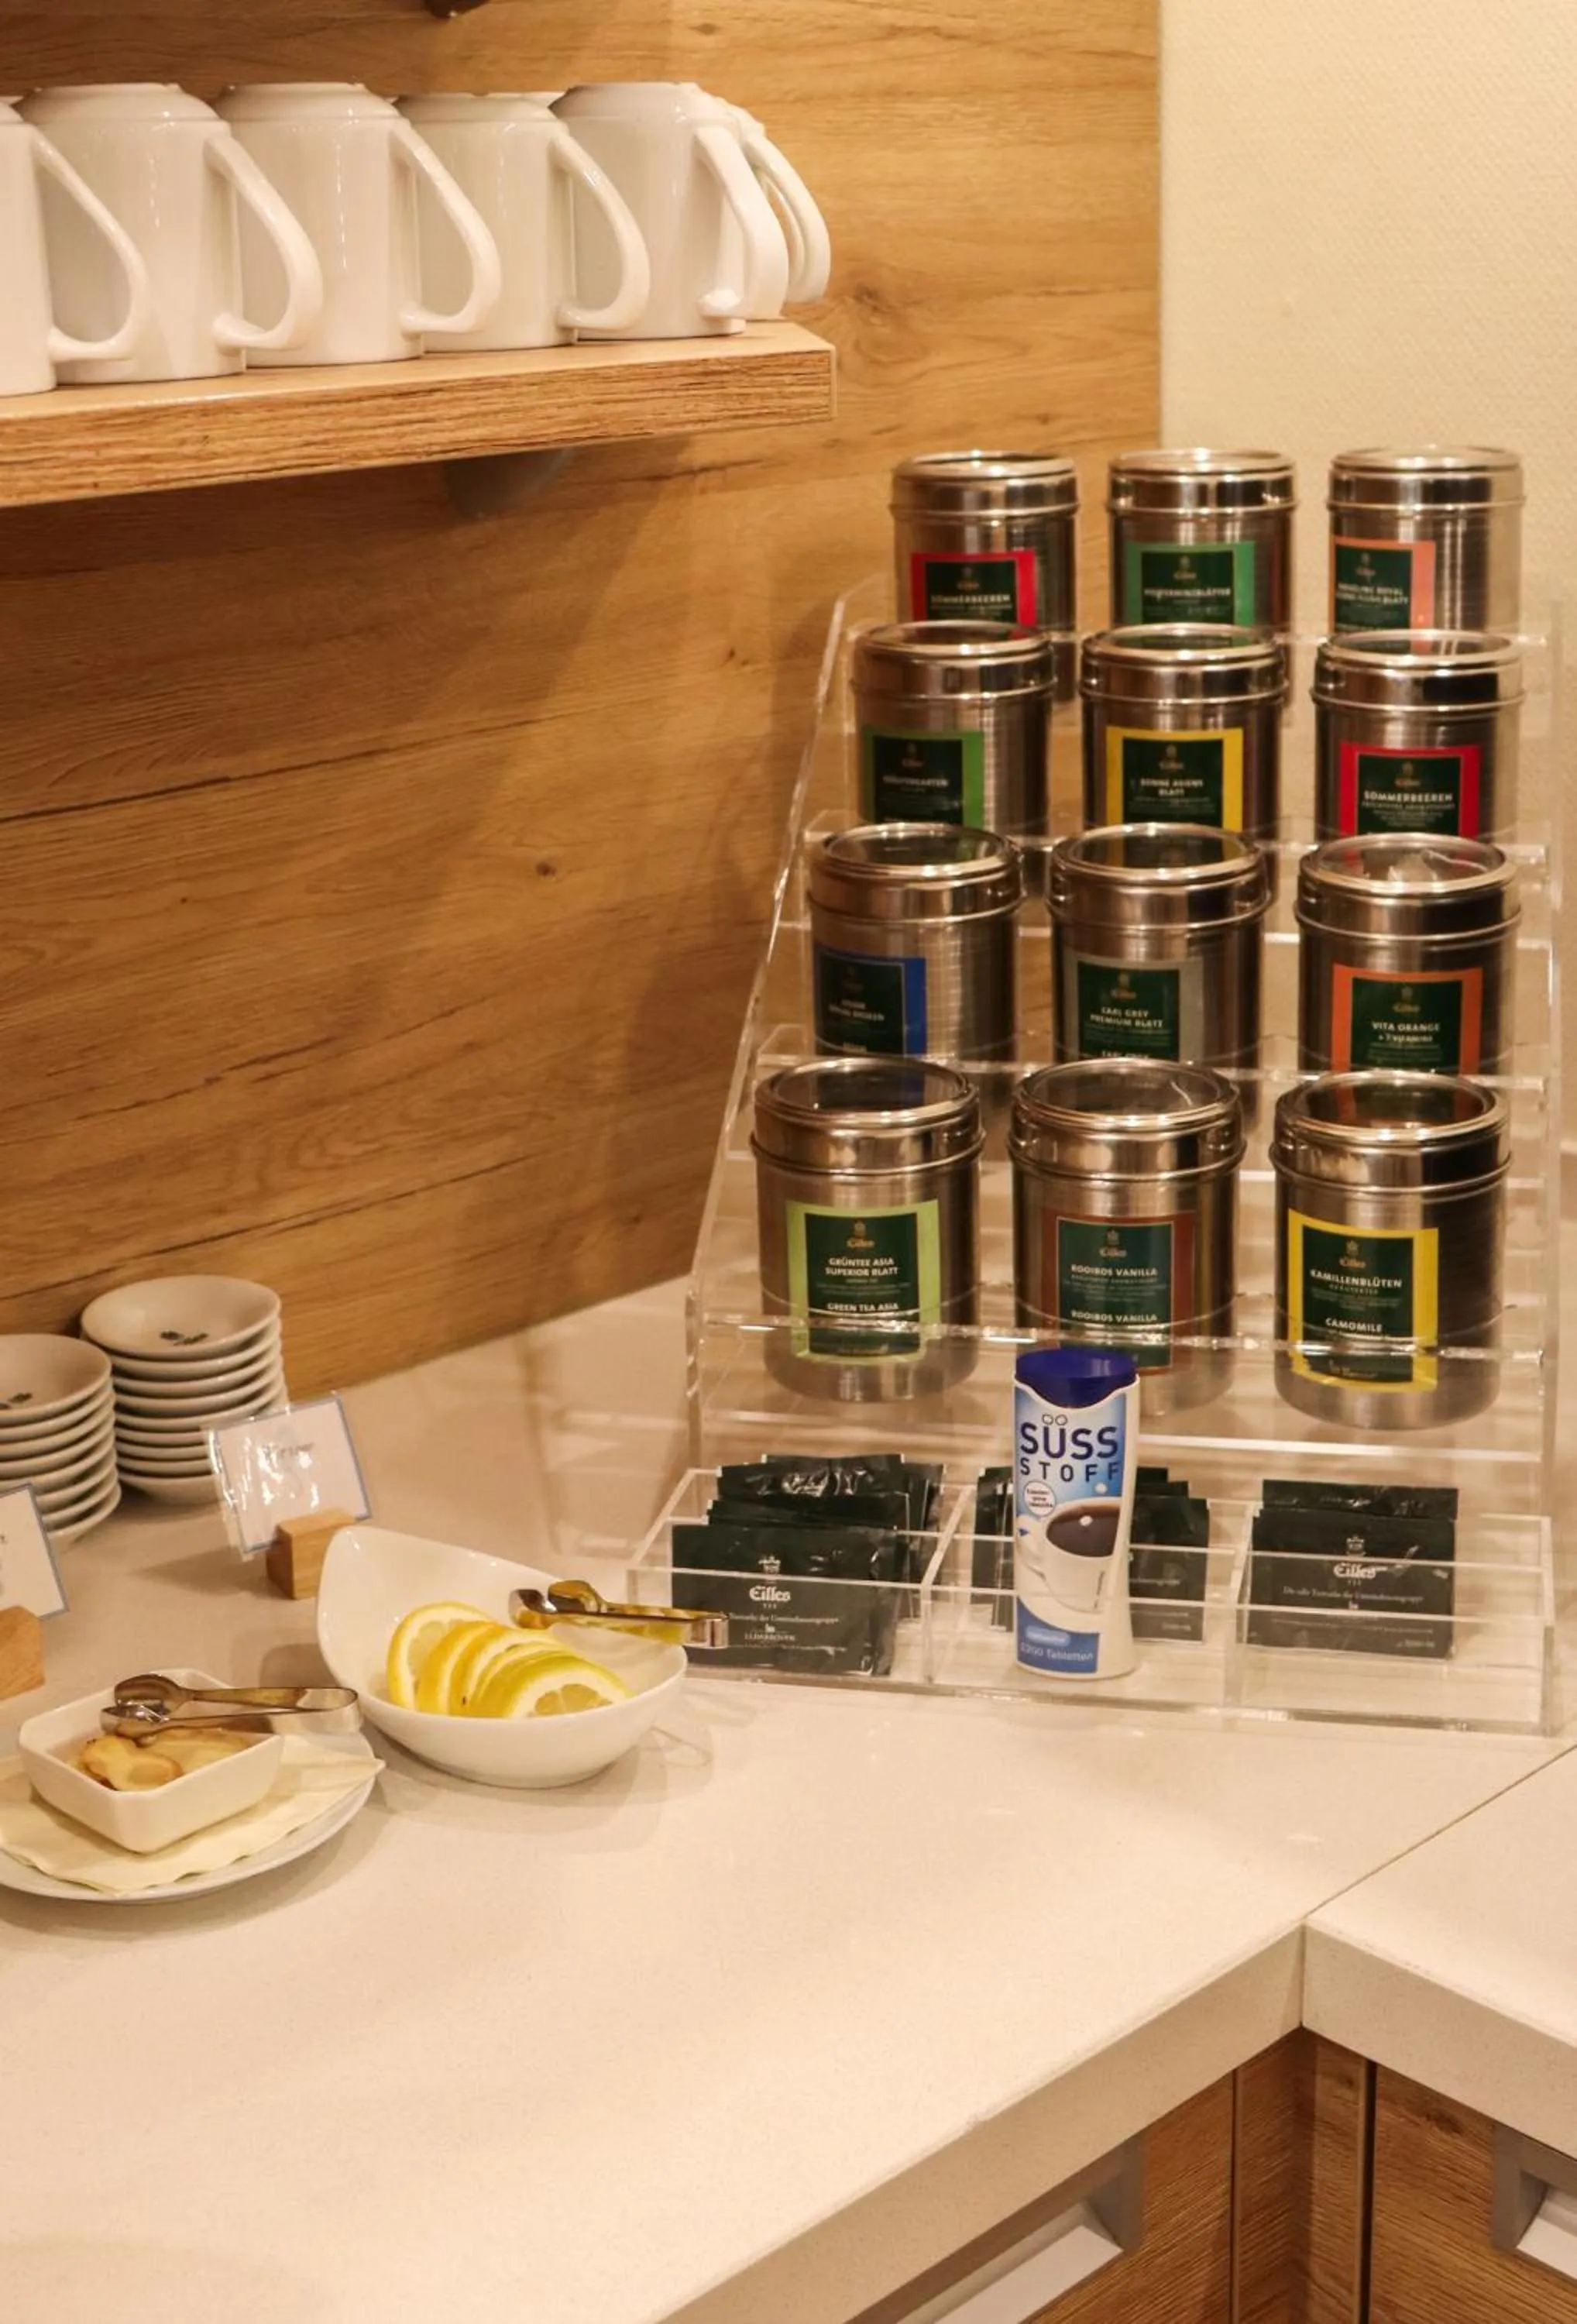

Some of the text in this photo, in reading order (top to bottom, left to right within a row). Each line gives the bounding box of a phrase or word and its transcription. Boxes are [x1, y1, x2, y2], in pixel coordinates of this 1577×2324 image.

[1363, 790, 1453, 803] SOMMERBEEREN
[1125, 1009, 1149, 1018] GREY
[1089, 1013, 1163, 1029] PREMIUM BLATT
[1372, 1021, 1440, 1032] VITA ORANGE
[828, 1257, 895, 1267] GRÜNTEE ASIA
[824, 1267, 898, 1277] SUPERIOR BLATT
[1070, 1263, 1158, 1277] ROOIBOS VANILLA
[1310, 1269, 1403, 1288] KAMILLENBLÜTEN
[826, 1302, 899, 1312] GREEN TEA ASIA
[1070, 1309, 1158, 1322] ROOIBOS VANILLA
[1324, 1317, 1383, 1333] CAMOMILE
[1019, 1414, 1119, 1460] SÜSS
[1019, 1457, 1121, 1483] STOFF
[1332, 1562, 1377, 1579] Eilles
[748, 1584, 792, 1603] Eilles
[1046, 1648, 1094, 1662] Tabletten
